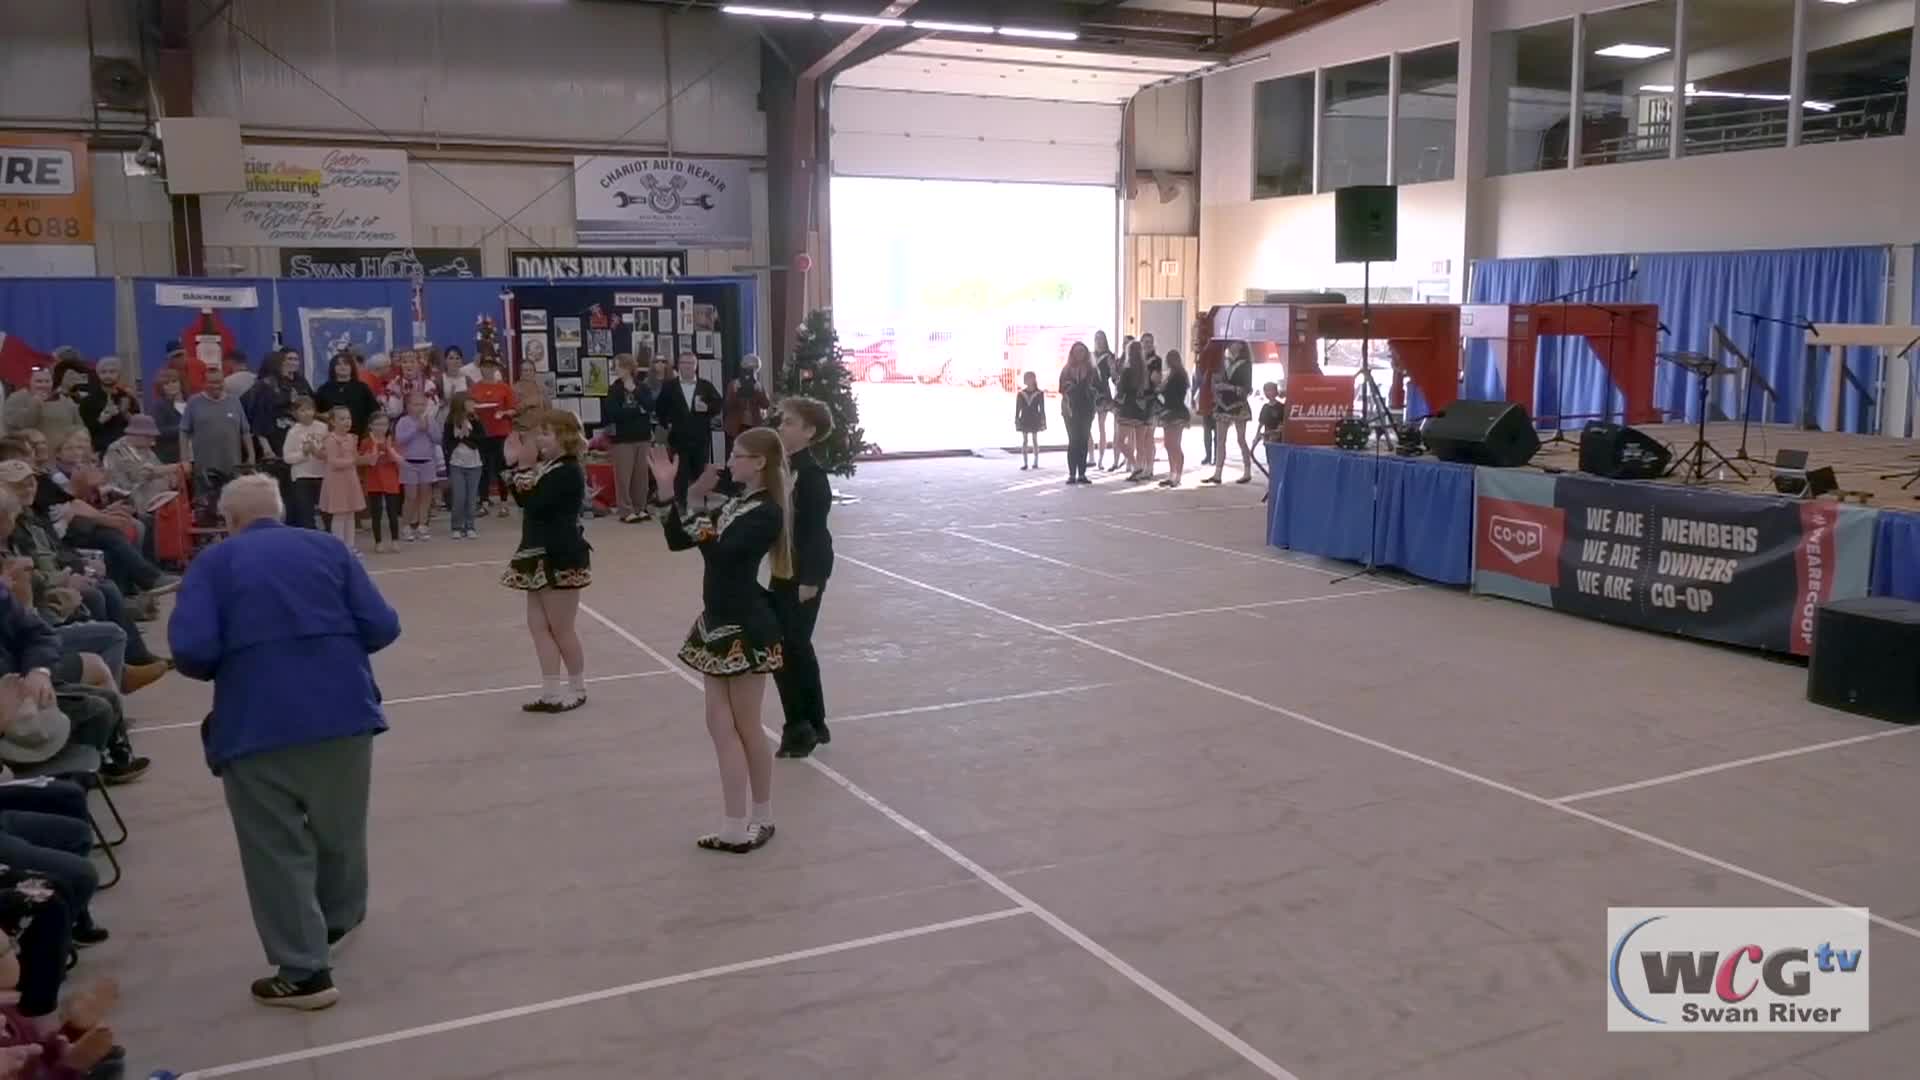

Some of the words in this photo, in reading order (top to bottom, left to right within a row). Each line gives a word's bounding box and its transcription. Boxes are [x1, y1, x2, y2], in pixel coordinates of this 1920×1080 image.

[600, 160, 649, 189] CHARIOT
[653, 159, 684, 172] AUTO
[687, 162, 727, 193] REPAIR
[4, 215, 81, 238] 4088
[290, 255, 356, 279] SWAN
[517, 257, 579, 279] DOAK'S
[582, 257, 629, 278] BULK
[630, 257, 682, 279] FUELS
[1290, 404, 1350, 418] FLAMAN
[1586, 507, 1613, 532] WE
[1614, 511, 1644, 538] ARE
[1662, 517, 1759, 552] MEMBERS
[1581, 539, 1608, 564] WE
[1609, 543, 1641, 569] ARE
[1657, 550, 1738, 584] OWNERS
[1576, 569, 1601, 595] WE
[1603, 575, 1634, 600] ARE
[1651, 582, 1714, 613] CO-OP
